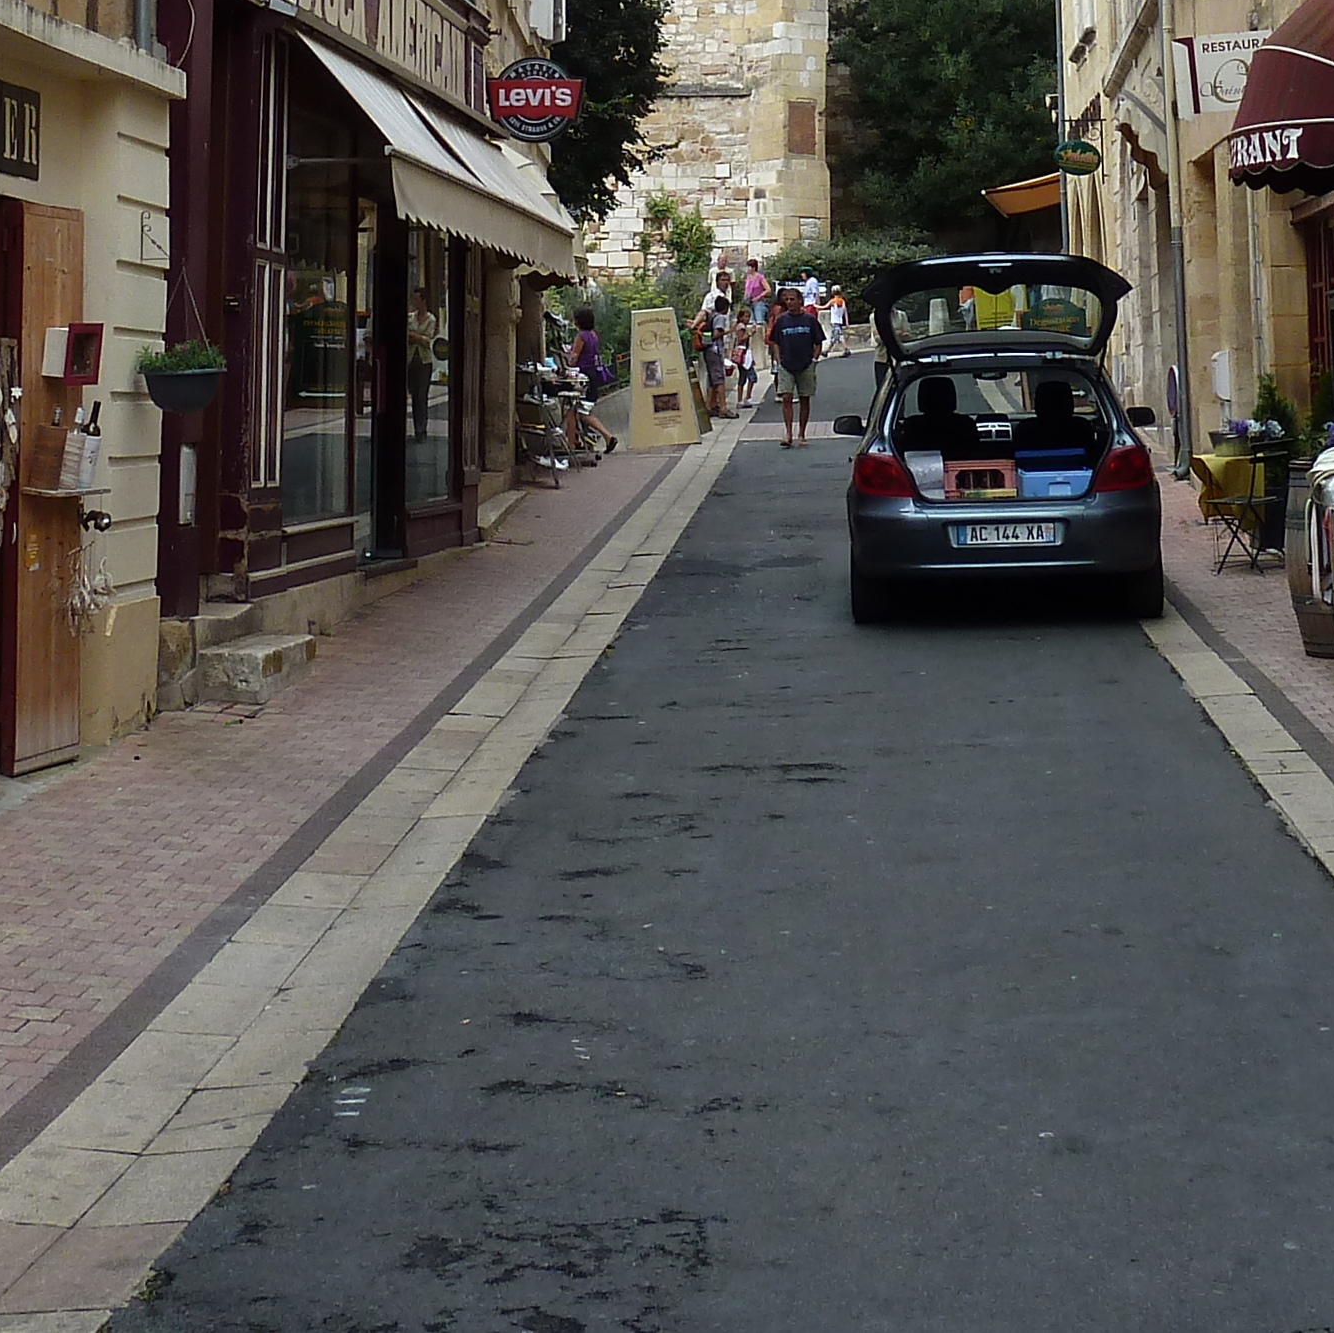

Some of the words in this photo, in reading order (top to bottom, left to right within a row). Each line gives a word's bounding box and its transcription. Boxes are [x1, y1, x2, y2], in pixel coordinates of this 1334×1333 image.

[970, 526, 988, 542] AC
[994, 525, 1020, 541] 144
[1026, 524, 1044, 540] XA
